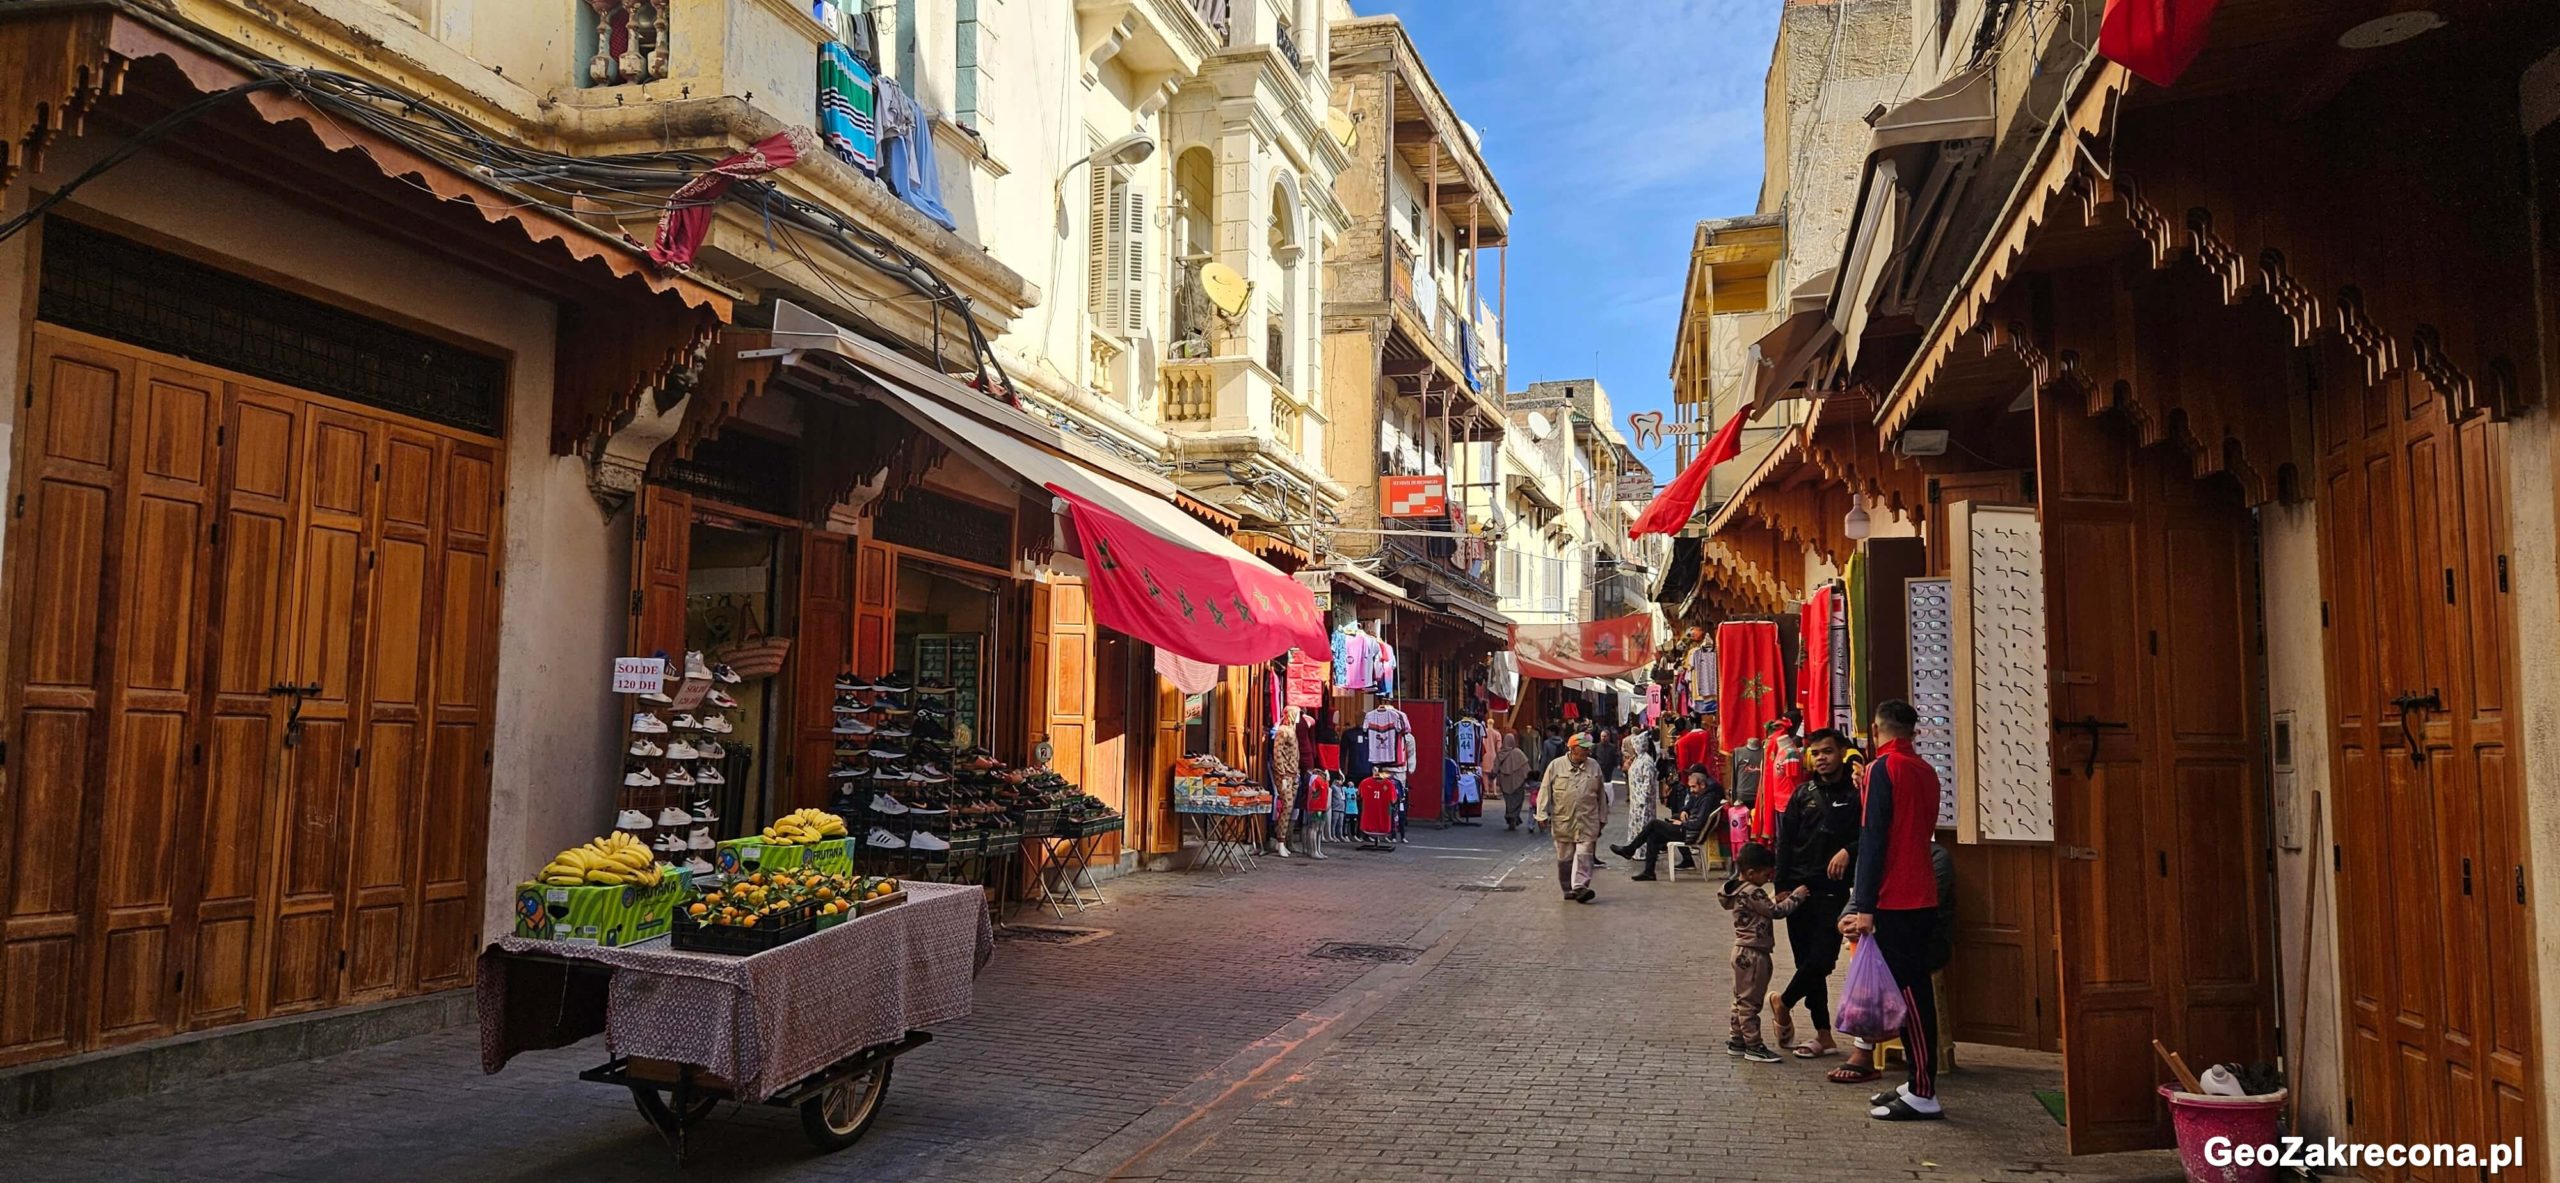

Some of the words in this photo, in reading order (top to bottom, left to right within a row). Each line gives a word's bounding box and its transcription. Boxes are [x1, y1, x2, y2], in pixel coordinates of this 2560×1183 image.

[618, 664, 658, 675] SOLDE
[618, 680, 636, 689] 120
[639, 681, 656, 690] DH
[1651, 693, 1659, 704] 10
[1461, 741, 1471, 750] 44
[813, 847, 843, 861] FRUTANA
[636, 881, 677, 900] FRUTANA
